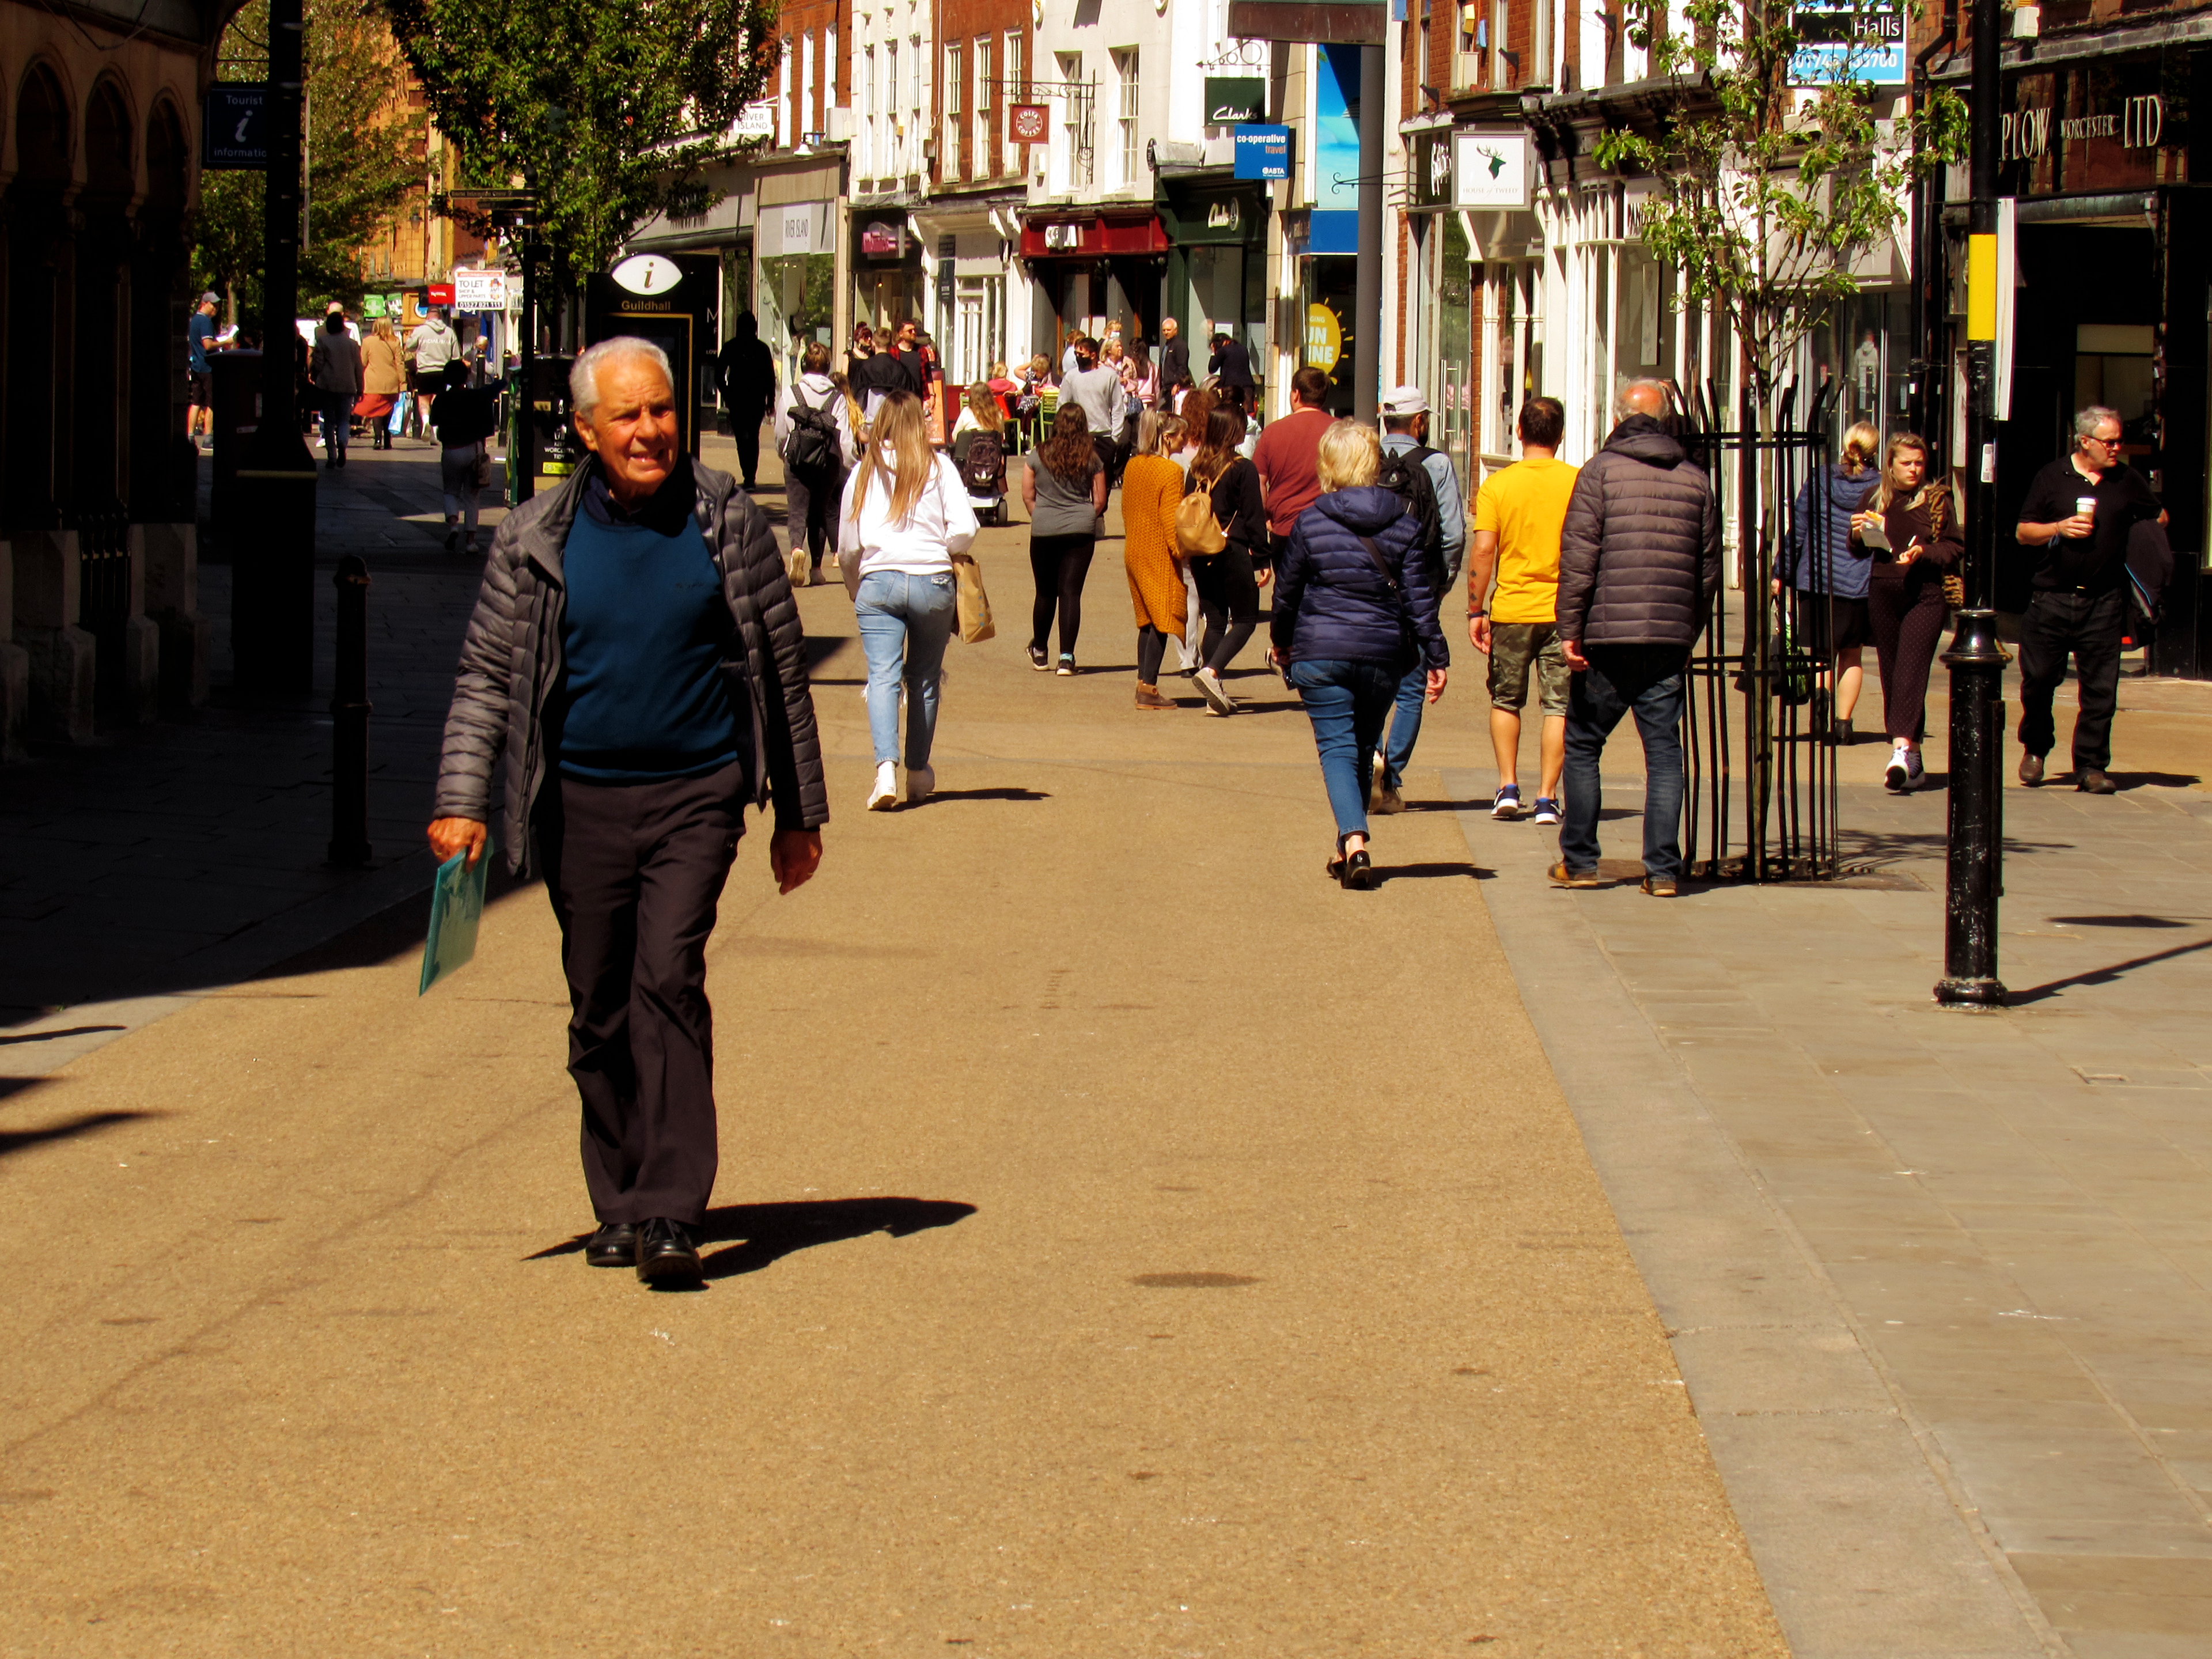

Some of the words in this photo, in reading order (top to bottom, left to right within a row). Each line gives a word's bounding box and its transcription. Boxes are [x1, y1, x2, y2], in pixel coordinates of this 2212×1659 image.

[1854, 16, 1900, 36] Halls
[226, 94, 263, 105] Tourist
[741, 113, 764, 121] RIVER
[1020, 111, 1039, 119] COSTA
[1212, 105, 1257, 122] Clarks
[737, 122, 768, 130] ISLAND
[1018, 125, 1040, 136] COFFEE
[1998, 107, 2052, 161] PLOW
[2124, 94, 2163, 149] LTD
[214, 147, 267, 157] informatio
[1266, 145, 1286, 154] travel
[459, 280, 470, 288] TO
[471, 280, 484, 288] LET
[621, 300, 671, 311] Guildhall
[1308, 345, 1334, 364] INE
